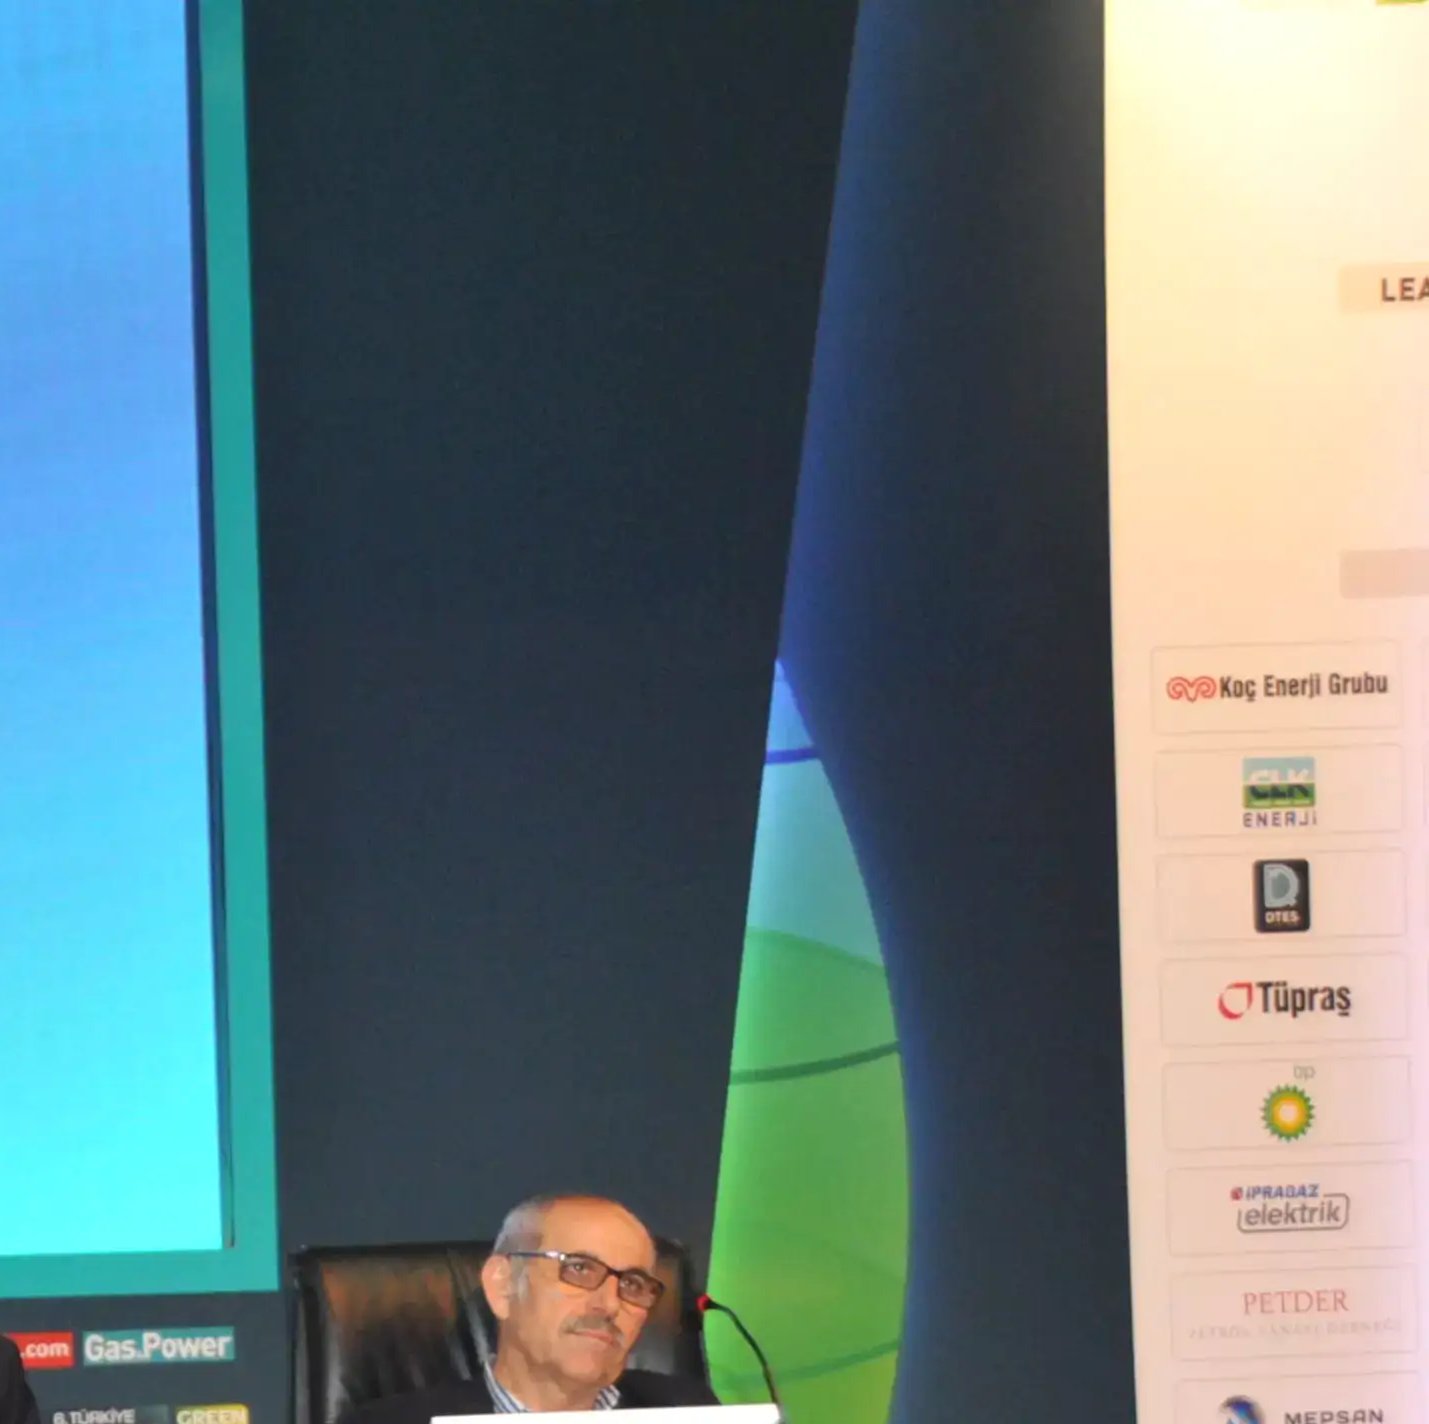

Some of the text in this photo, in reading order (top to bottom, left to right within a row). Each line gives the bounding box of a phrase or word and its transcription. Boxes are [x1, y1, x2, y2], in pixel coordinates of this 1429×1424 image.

[1220, 672, 1388, 702] Koç Enerji Grubu
[1248, 768, 1310, 799] CLK
[1256, 981, 1351, 1018] Tüpraş
[1245, 1202, 1340, 1225] elektrik
[1242, 1289, 1349, 1315] PETDER
[85, 1332, 231, 1362] Gas.Power
